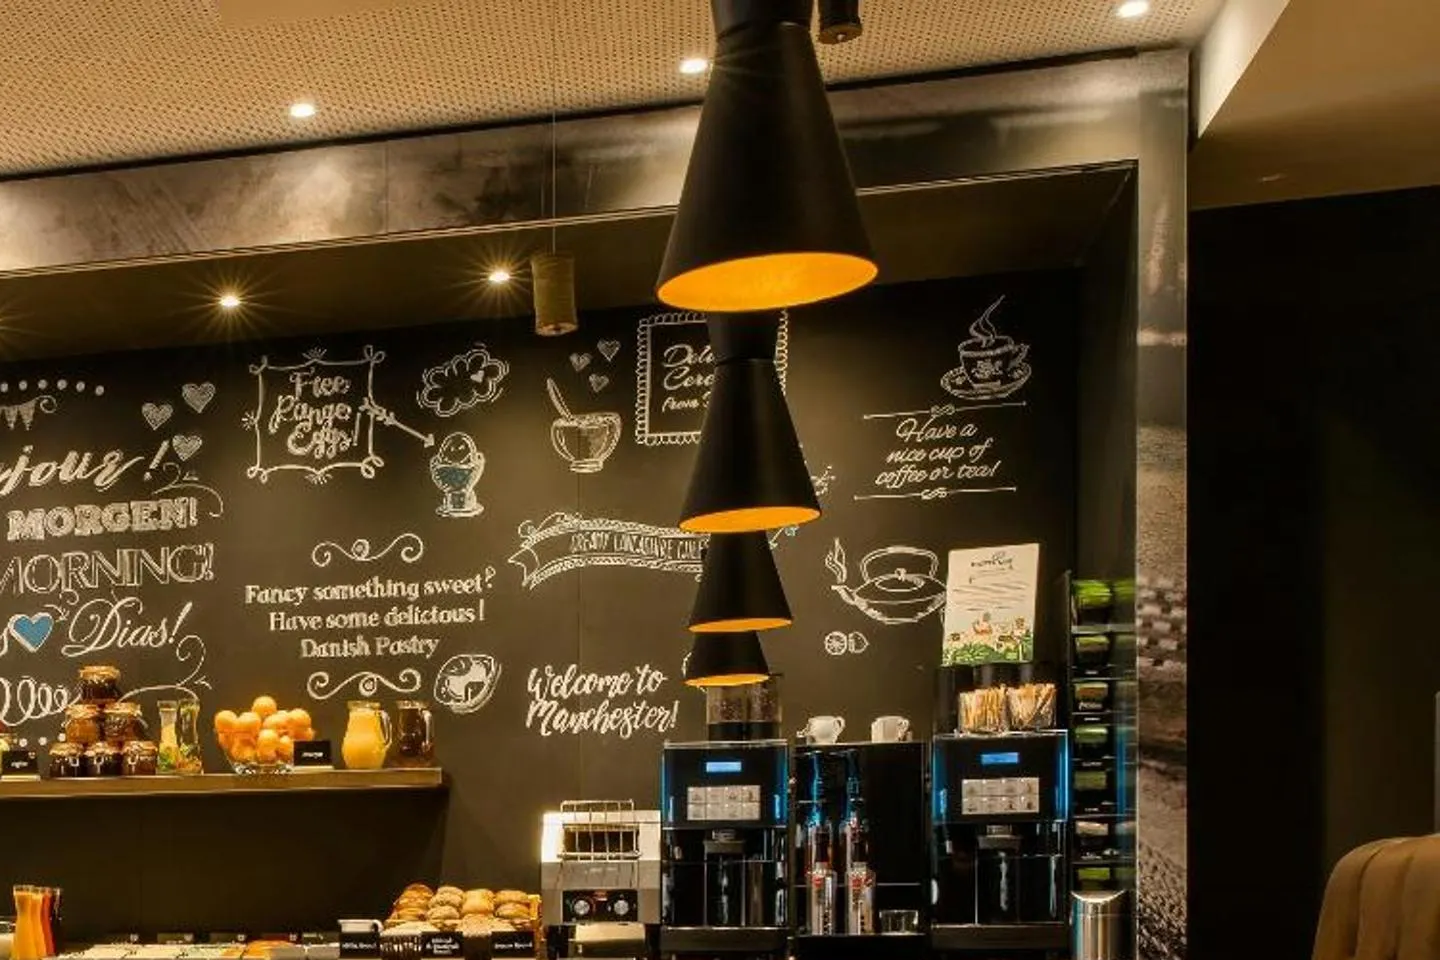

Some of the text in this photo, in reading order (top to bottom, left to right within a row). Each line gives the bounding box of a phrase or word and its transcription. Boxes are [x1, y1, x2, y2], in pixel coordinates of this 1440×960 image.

[289, 367, 351, 400] Free
[269, 395, 352, 434] Range
[896, 416, 978, 442] Have a
[886, 437, 994, 464] nice cup of
[875, 464, 928, 488] coffee
[929, 466, 954, 481] or
[7, 497, 199, 542] MORGEN!
[244, 566, 496, 606] Fancy something sweet?
[269, 611, 322, 631] Have
[326, 613, 380, 629] some
[300, 634, 441, 659] Danish Pastry
[527, 663, 668, 700] Welcome to
[525, 699, 680, 740] Manchester!
